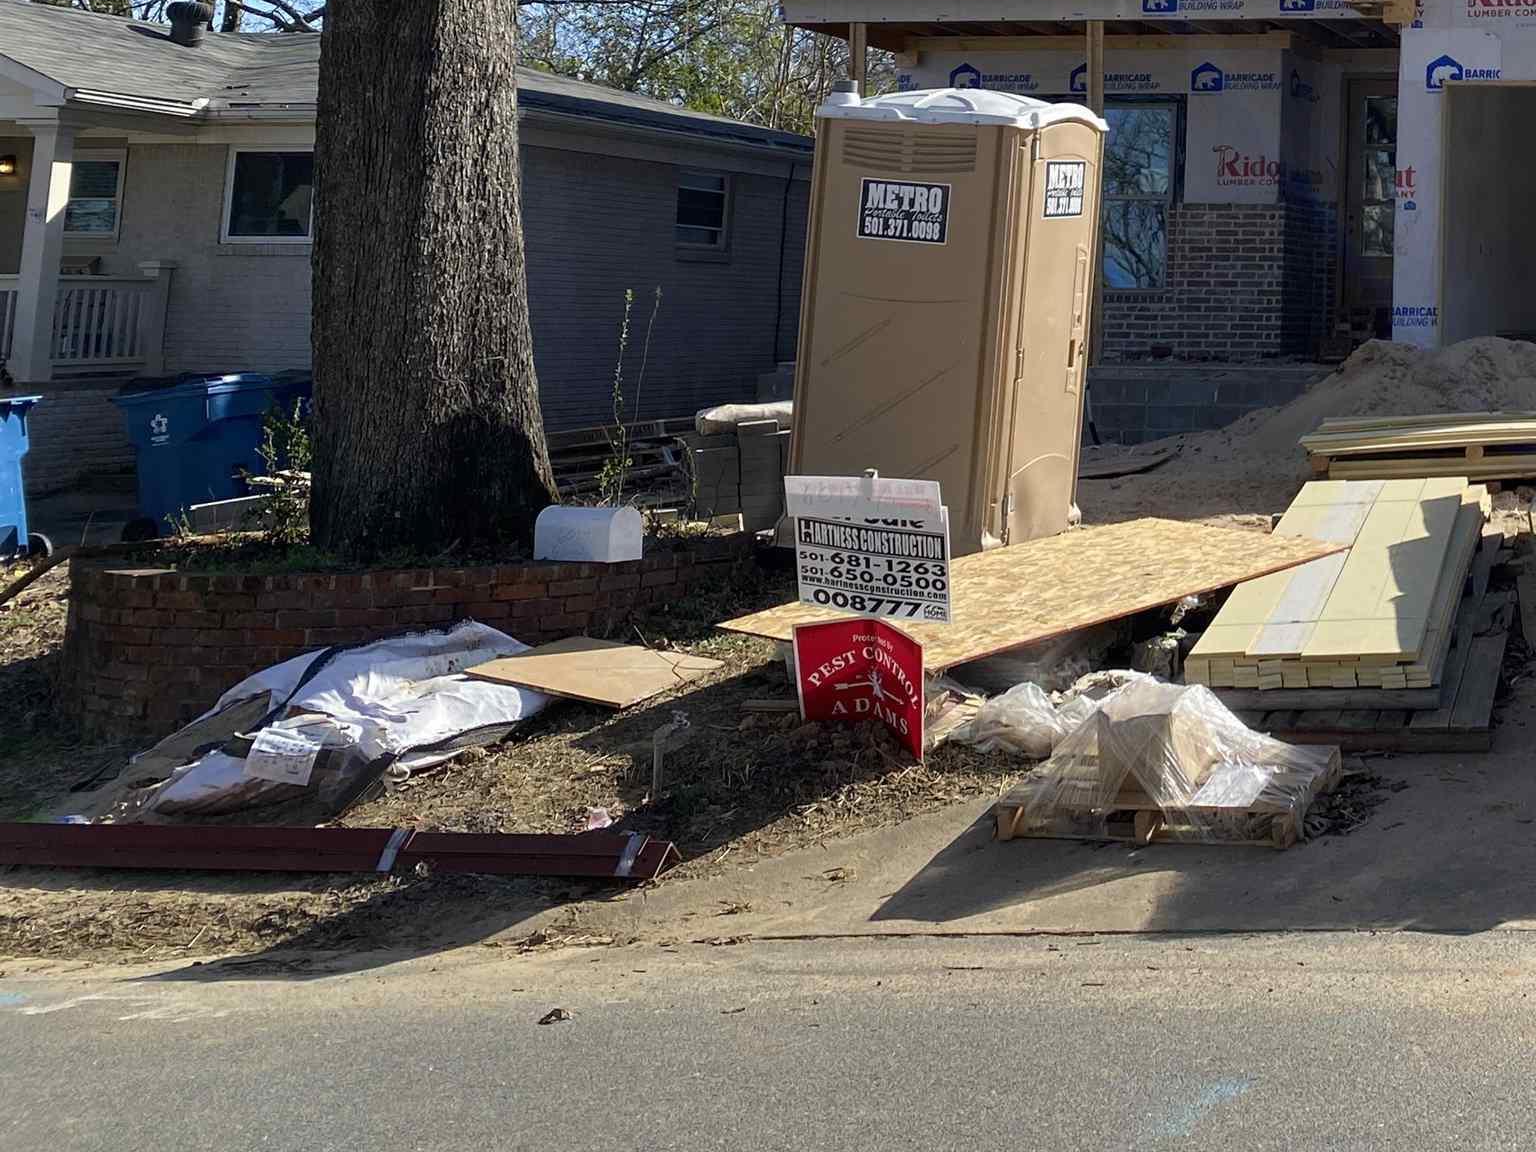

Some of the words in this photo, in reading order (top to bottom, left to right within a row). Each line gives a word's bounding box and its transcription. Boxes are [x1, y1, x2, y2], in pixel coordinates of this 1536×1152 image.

[1467, 9, 1512, 18] LUMBER
[982, 74, 1033, 82] BARRICADE
[1224, 73, 1275, 81] BARRICADE
[1465, 69, 1500, 79] BARRIC
[1212, 145, 1280, 177] Rido
[1047, 163, 1083, 189] METRO
[865, 182, 942, 214] METRO
[864, 217, 940, 241] 501.371.0098
[800, 519, 860, 551] HARTNESS
[860, 530, 942, 559] CONSTRUCTION
[800, 551, 946, 577] 501-681-1263
[801, 565, 946, 591] 501-650-0500
[813, 589, 921, 617] 008777
[808, 650, 856, 687] PEST
[862, 647, 919, 709] CONTROL
[832, 698, 908, 735] ADAMS
